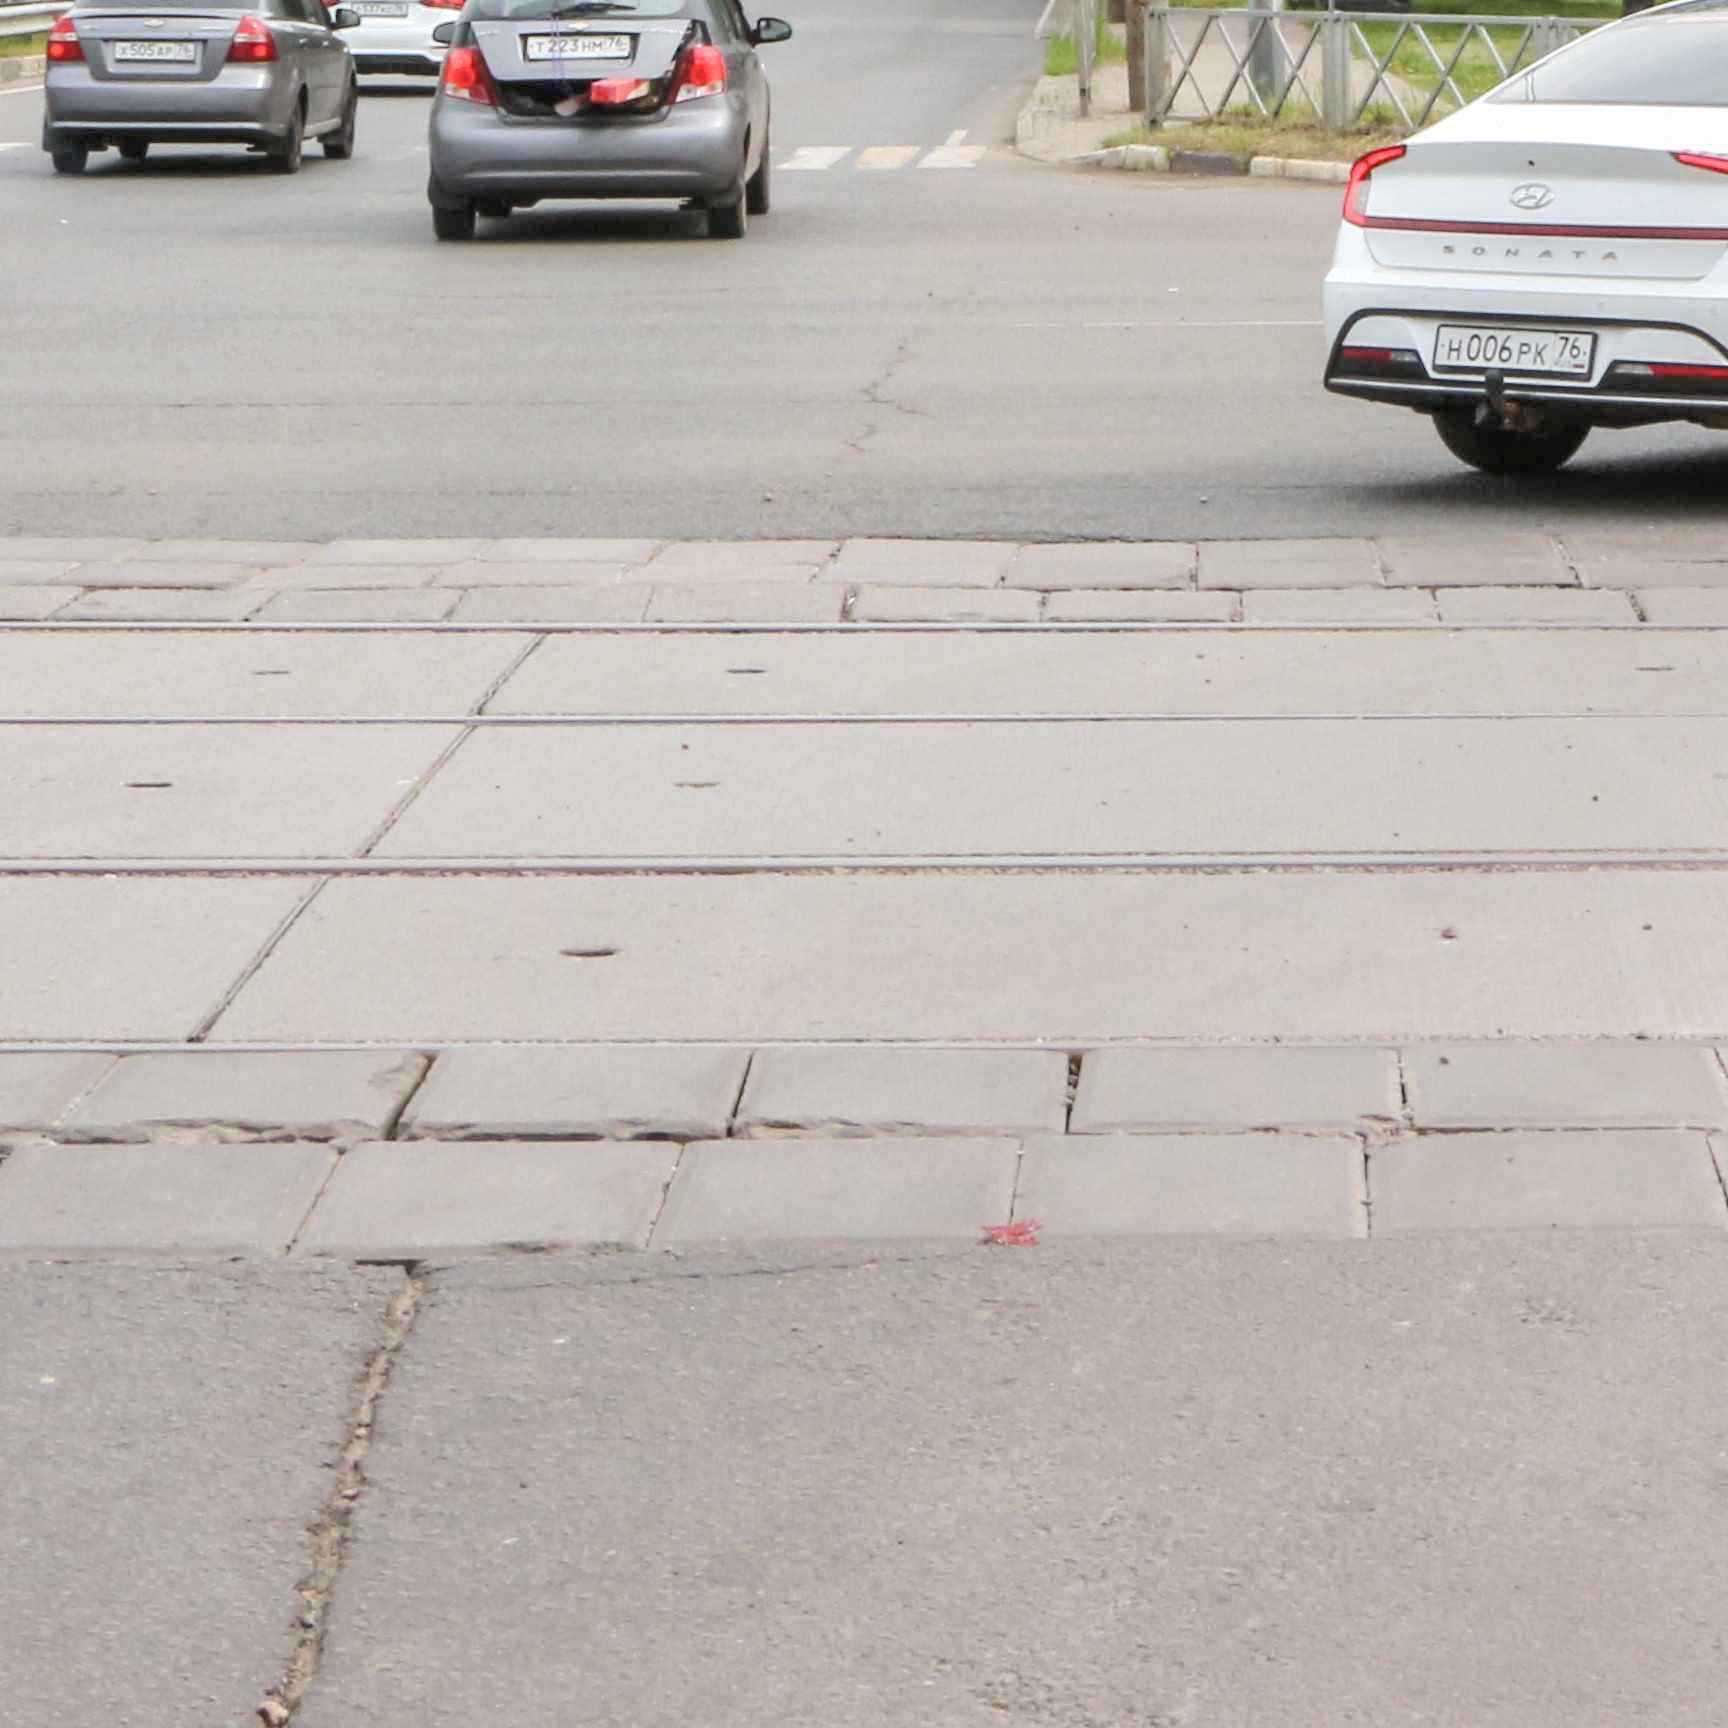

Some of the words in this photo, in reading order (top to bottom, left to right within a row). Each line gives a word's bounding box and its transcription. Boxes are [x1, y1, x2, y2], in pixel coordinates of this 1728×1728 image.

[1442, 244, 1618, 261] SONATA
[1446, 334, 1549, 366] Н006РК
[1558, 336, 1581, 359] 76
